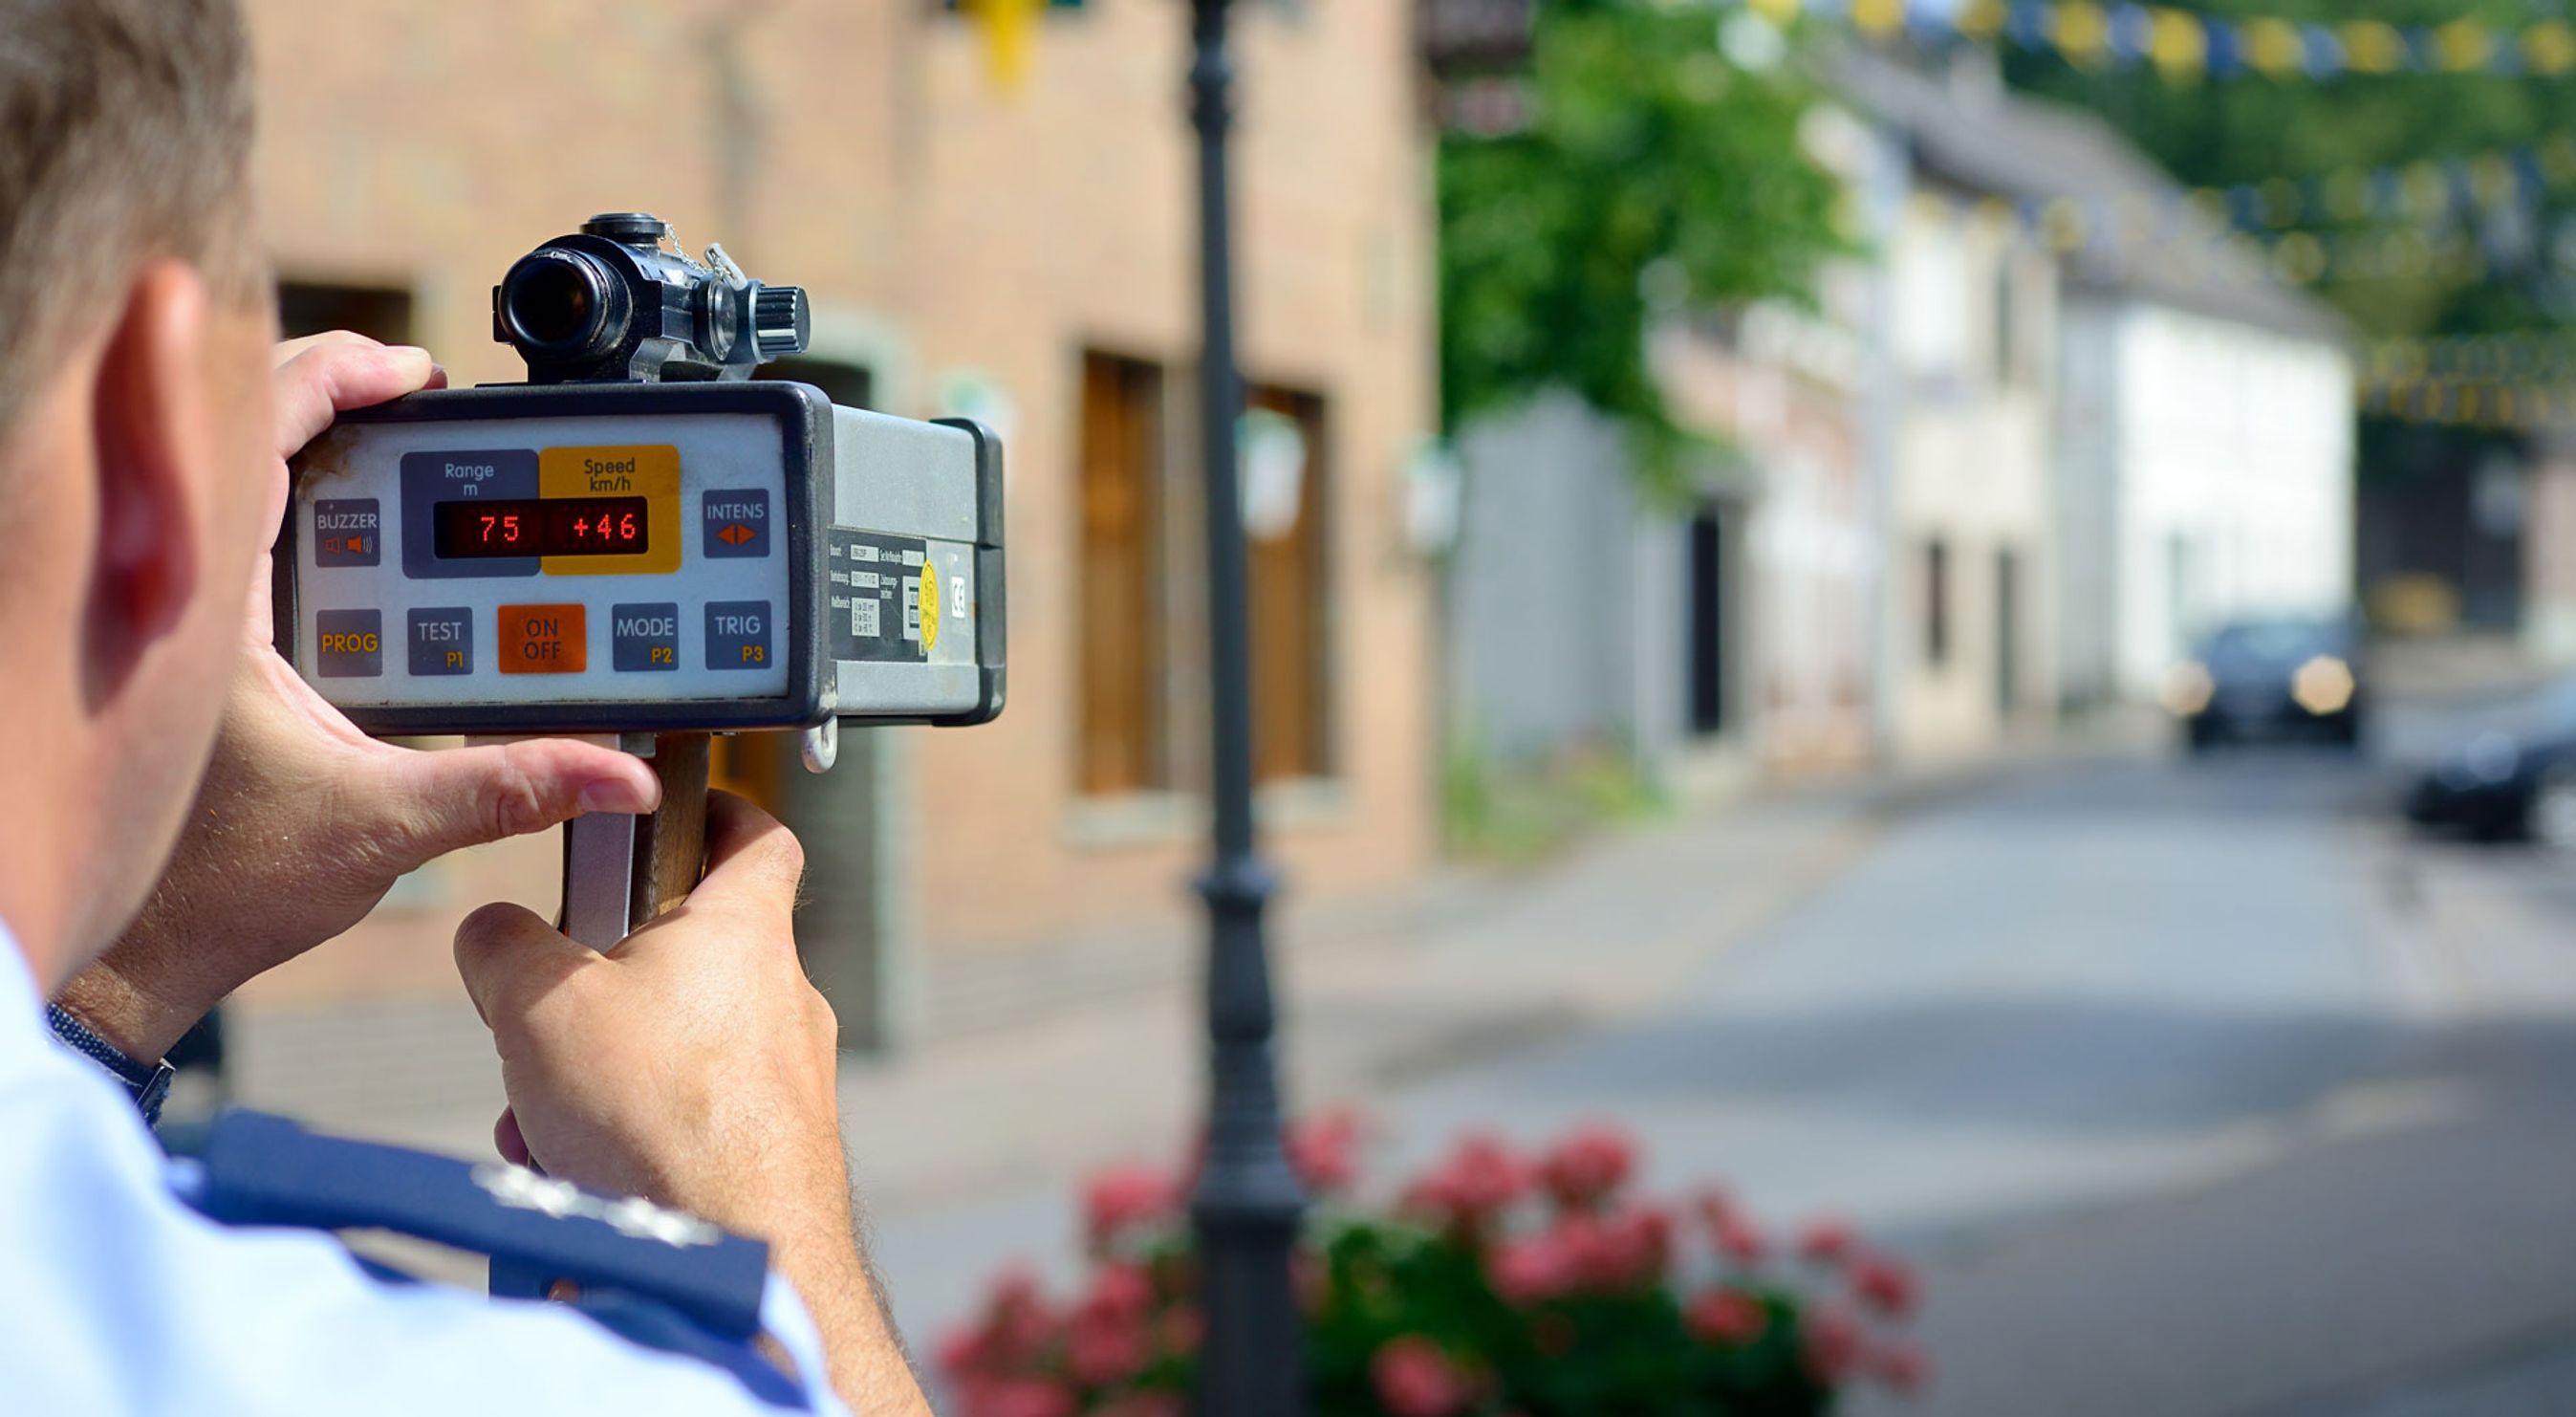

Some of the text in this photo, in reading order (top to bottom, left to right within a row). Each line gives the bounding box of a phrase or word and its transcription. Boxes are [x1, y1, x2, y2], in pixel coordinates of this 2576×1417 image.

[444, 463, 494, 480] Range
[584, 458, 635, 478] Speed
[464, 483, 478, 496] m
[590, 478, 631, 491] km/h
[707, 503, 764, 520] INTENS
[317, 513, 378, 530] BUZZER
[481, 516, 518, 541] 75
[574, 513, 636, 539] +46
[418, 621, 462, 641] TEST
[526, 620, 559, 638] ON
[617, 618, 673, 637] MODE
[715, 616, 761, 635] TRIG
[321, 633, 379, 653] PROG
[523, 642, 561, 660] OFF
[446, 651, 464, 668] P1
[651, 647, 672, 664] P2
[742, 645, 764, 663] P3
